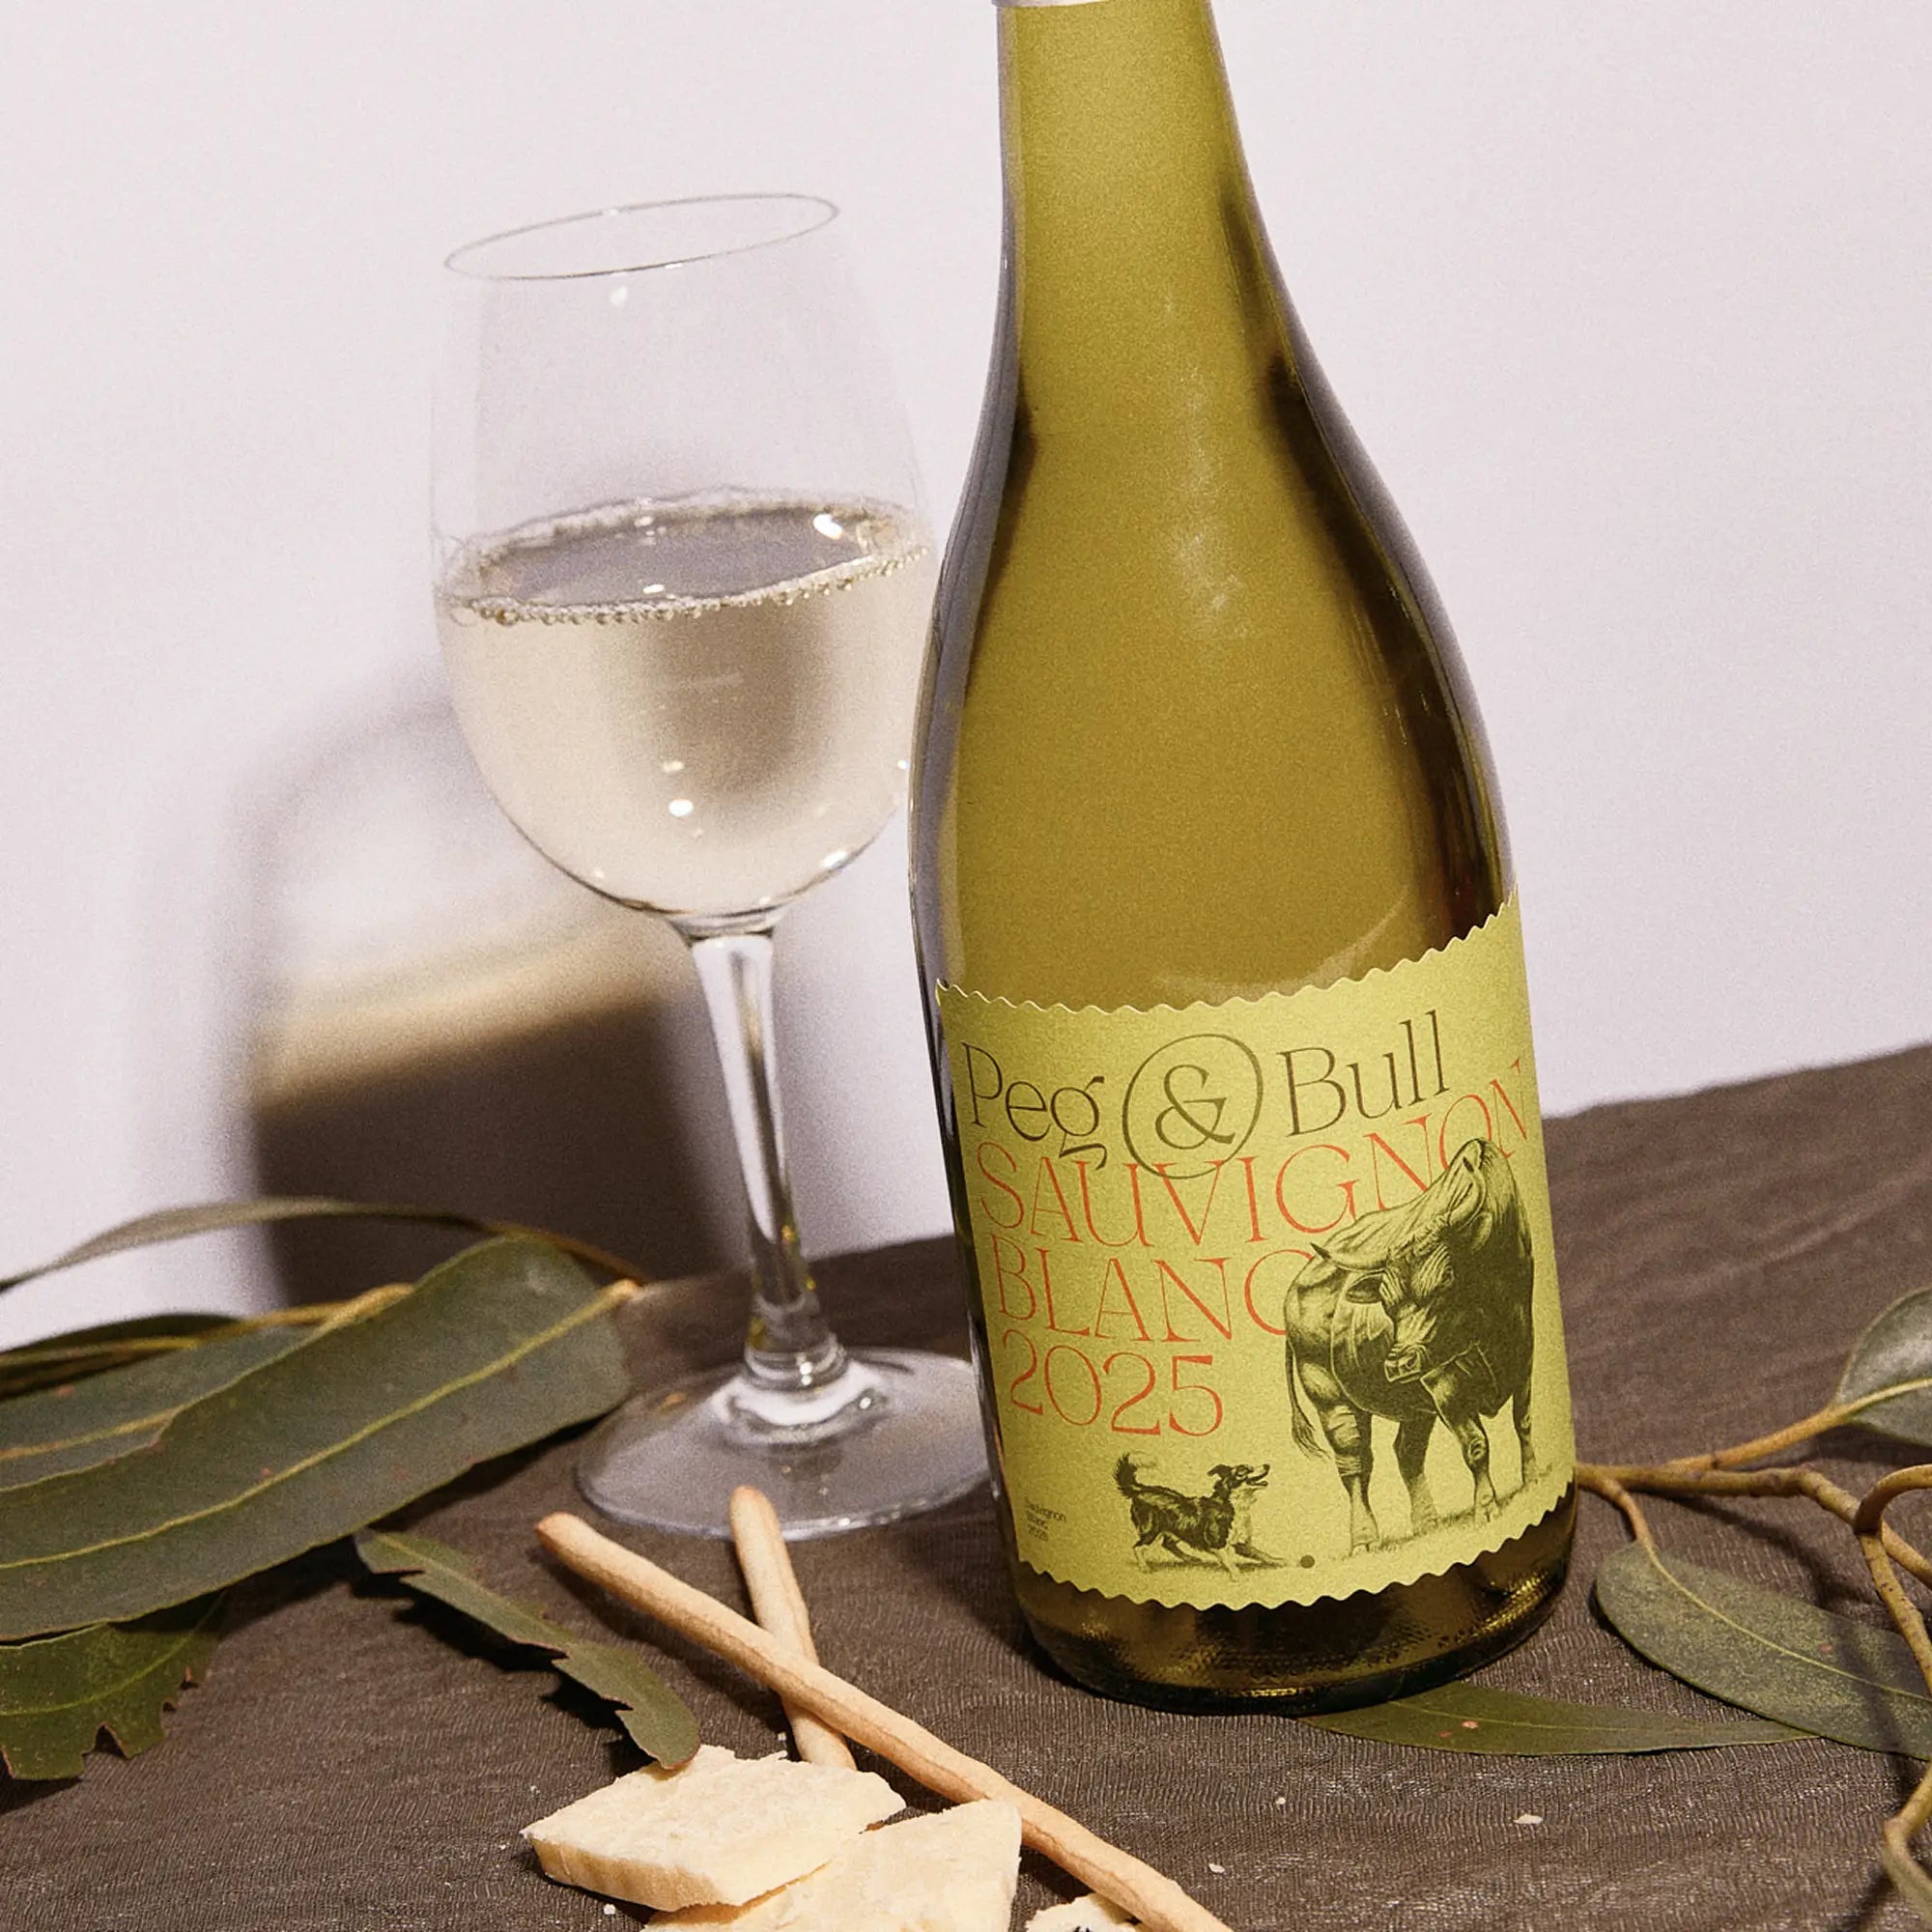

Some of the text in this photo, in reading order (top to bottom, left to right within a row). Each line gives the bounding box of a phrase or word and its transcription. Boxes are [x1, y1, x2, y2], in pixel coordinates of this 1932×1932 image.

[961, 1042, 1107, 1169] Peg
[1278, 1009, 1450, 1137] Bull
[977, 1061, 1529, 1247] SAUVIGNON
[992, 1235, 1315, 1343] BLANC
[1004, 1330, 1223, 1437] 2025
